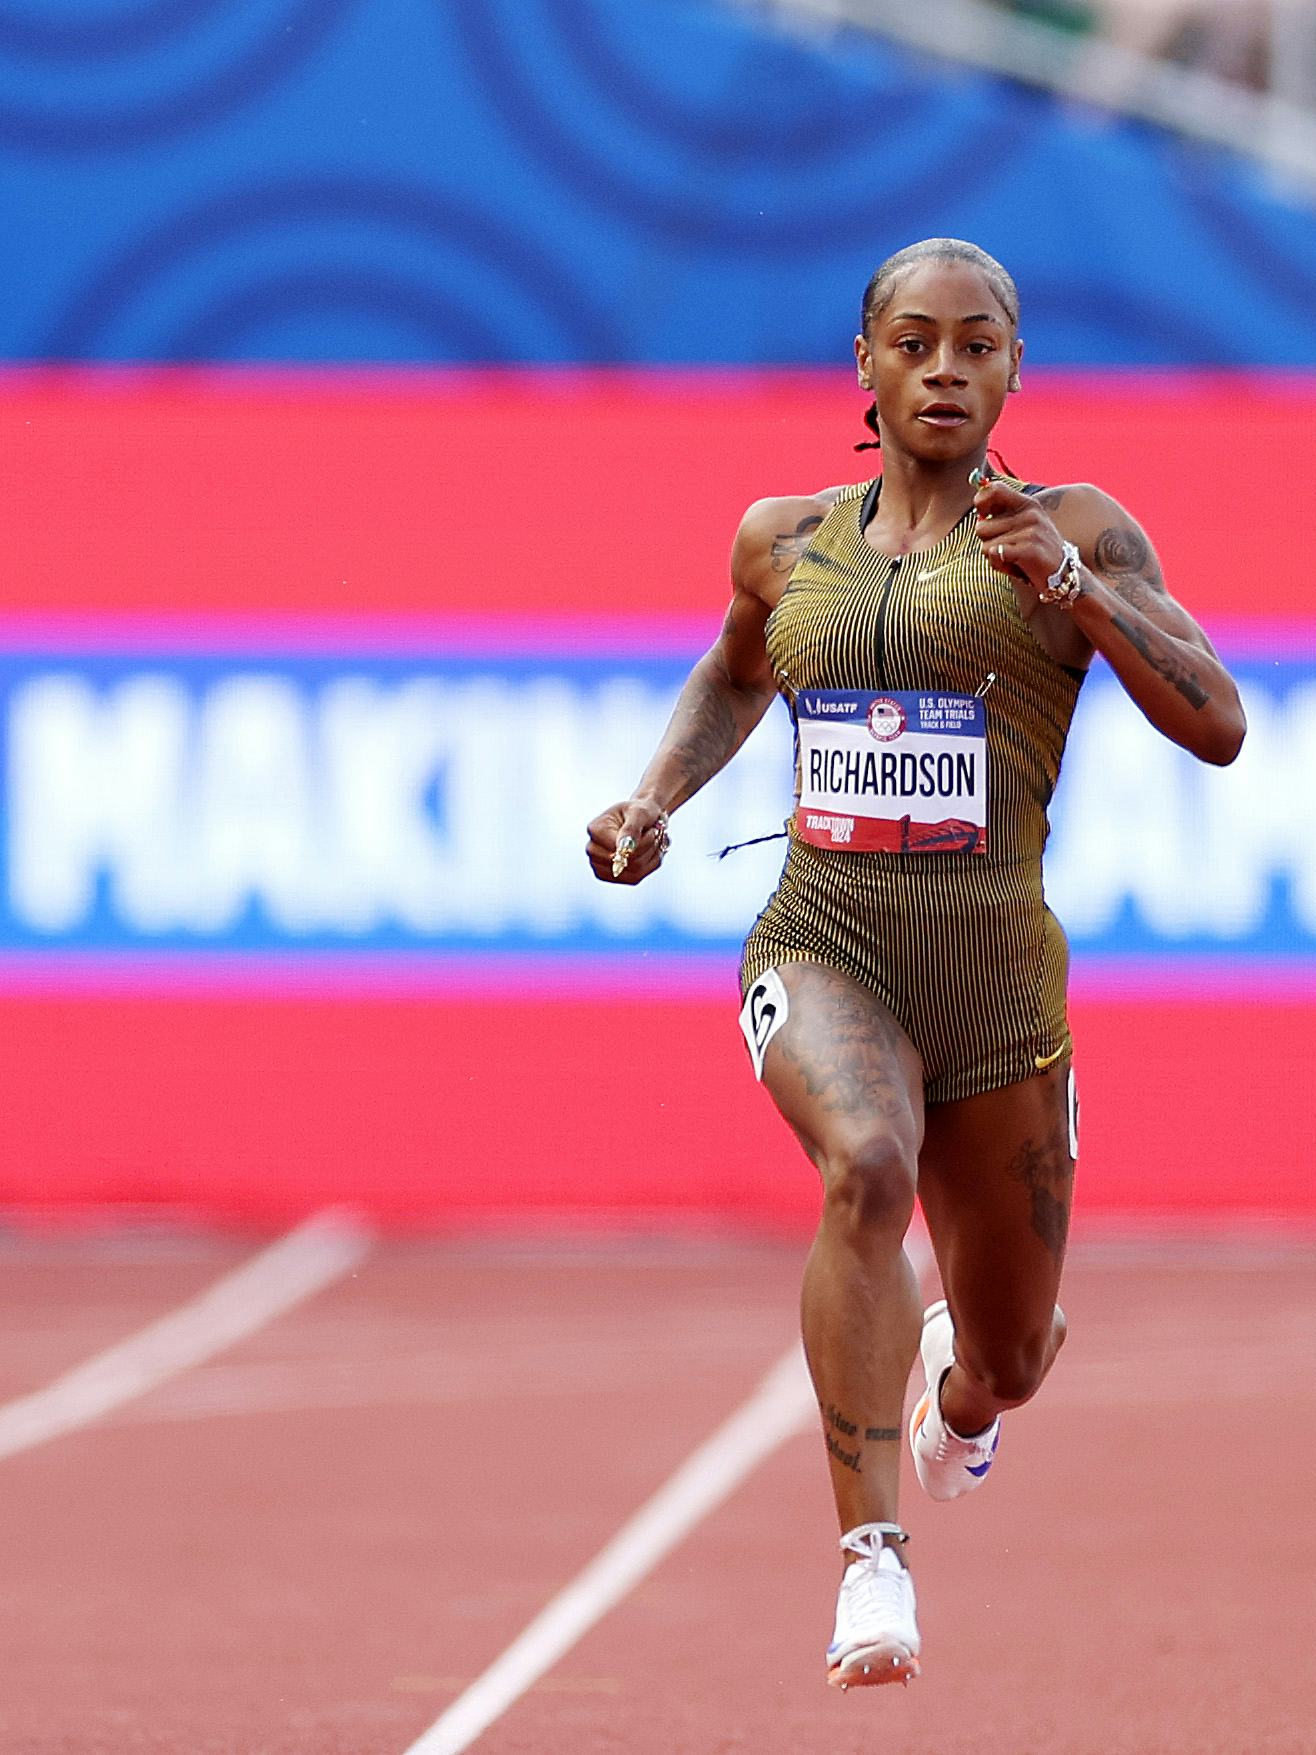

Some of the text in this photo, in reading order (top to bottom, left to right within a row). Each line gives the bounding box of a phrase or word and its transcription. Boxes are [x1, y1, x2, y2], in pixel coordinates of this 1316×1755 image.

[821, 702, 858, 714] USATF
[919, 697, 975, 709] U.S. OLYMPIC
[919, 709, 975, 721] TEAM TRIALS
[810, 748, 975, 797] RICHARDSON
